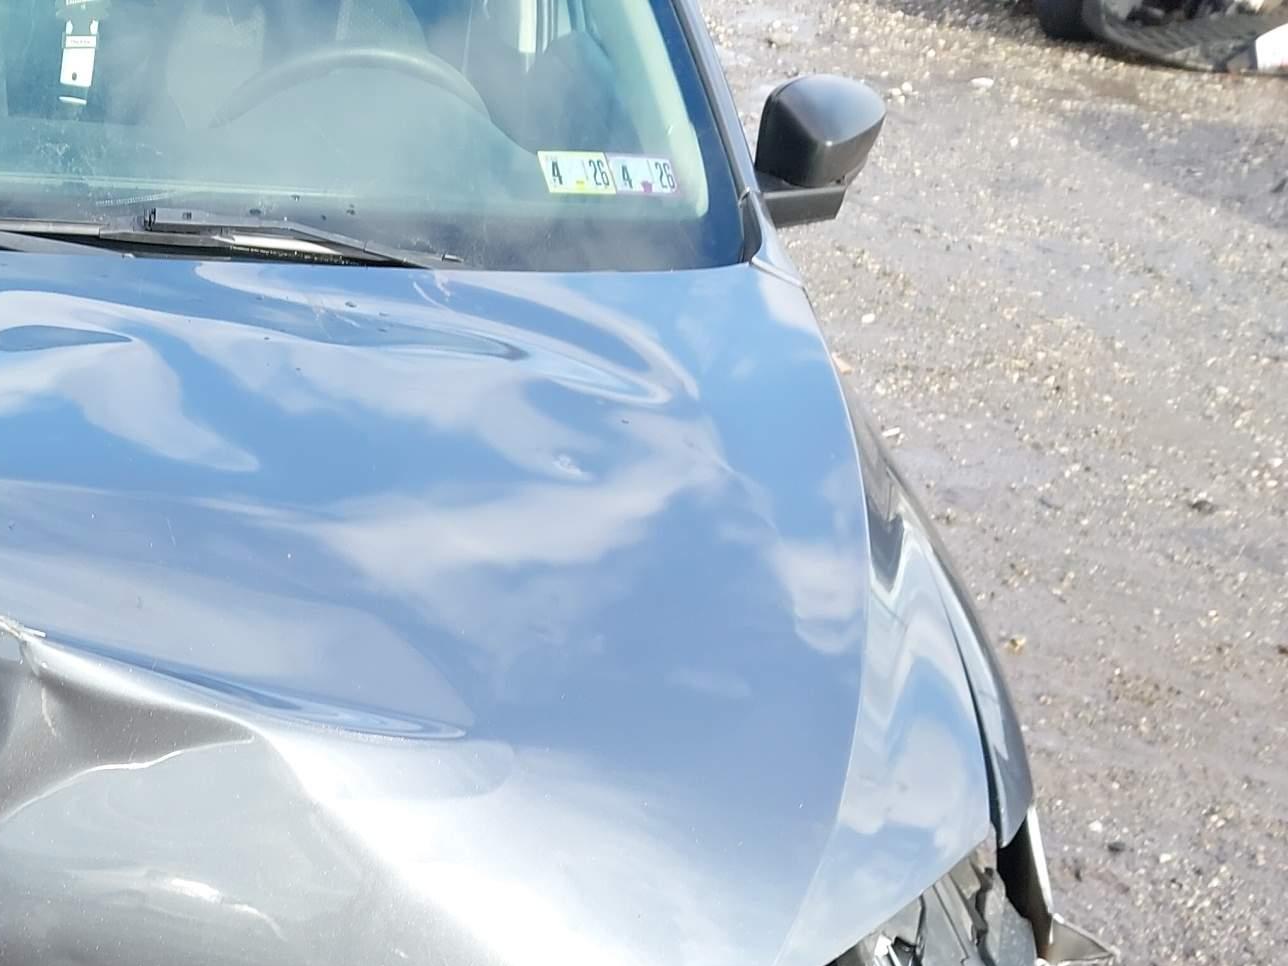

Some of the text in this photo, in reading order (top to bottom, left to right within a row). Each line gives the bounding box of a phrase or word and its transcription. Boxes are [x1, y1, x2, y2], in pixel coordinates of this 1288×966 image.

[551, 159, 610, 186] 4 26
[621, 161, 676, 189] 4 26
